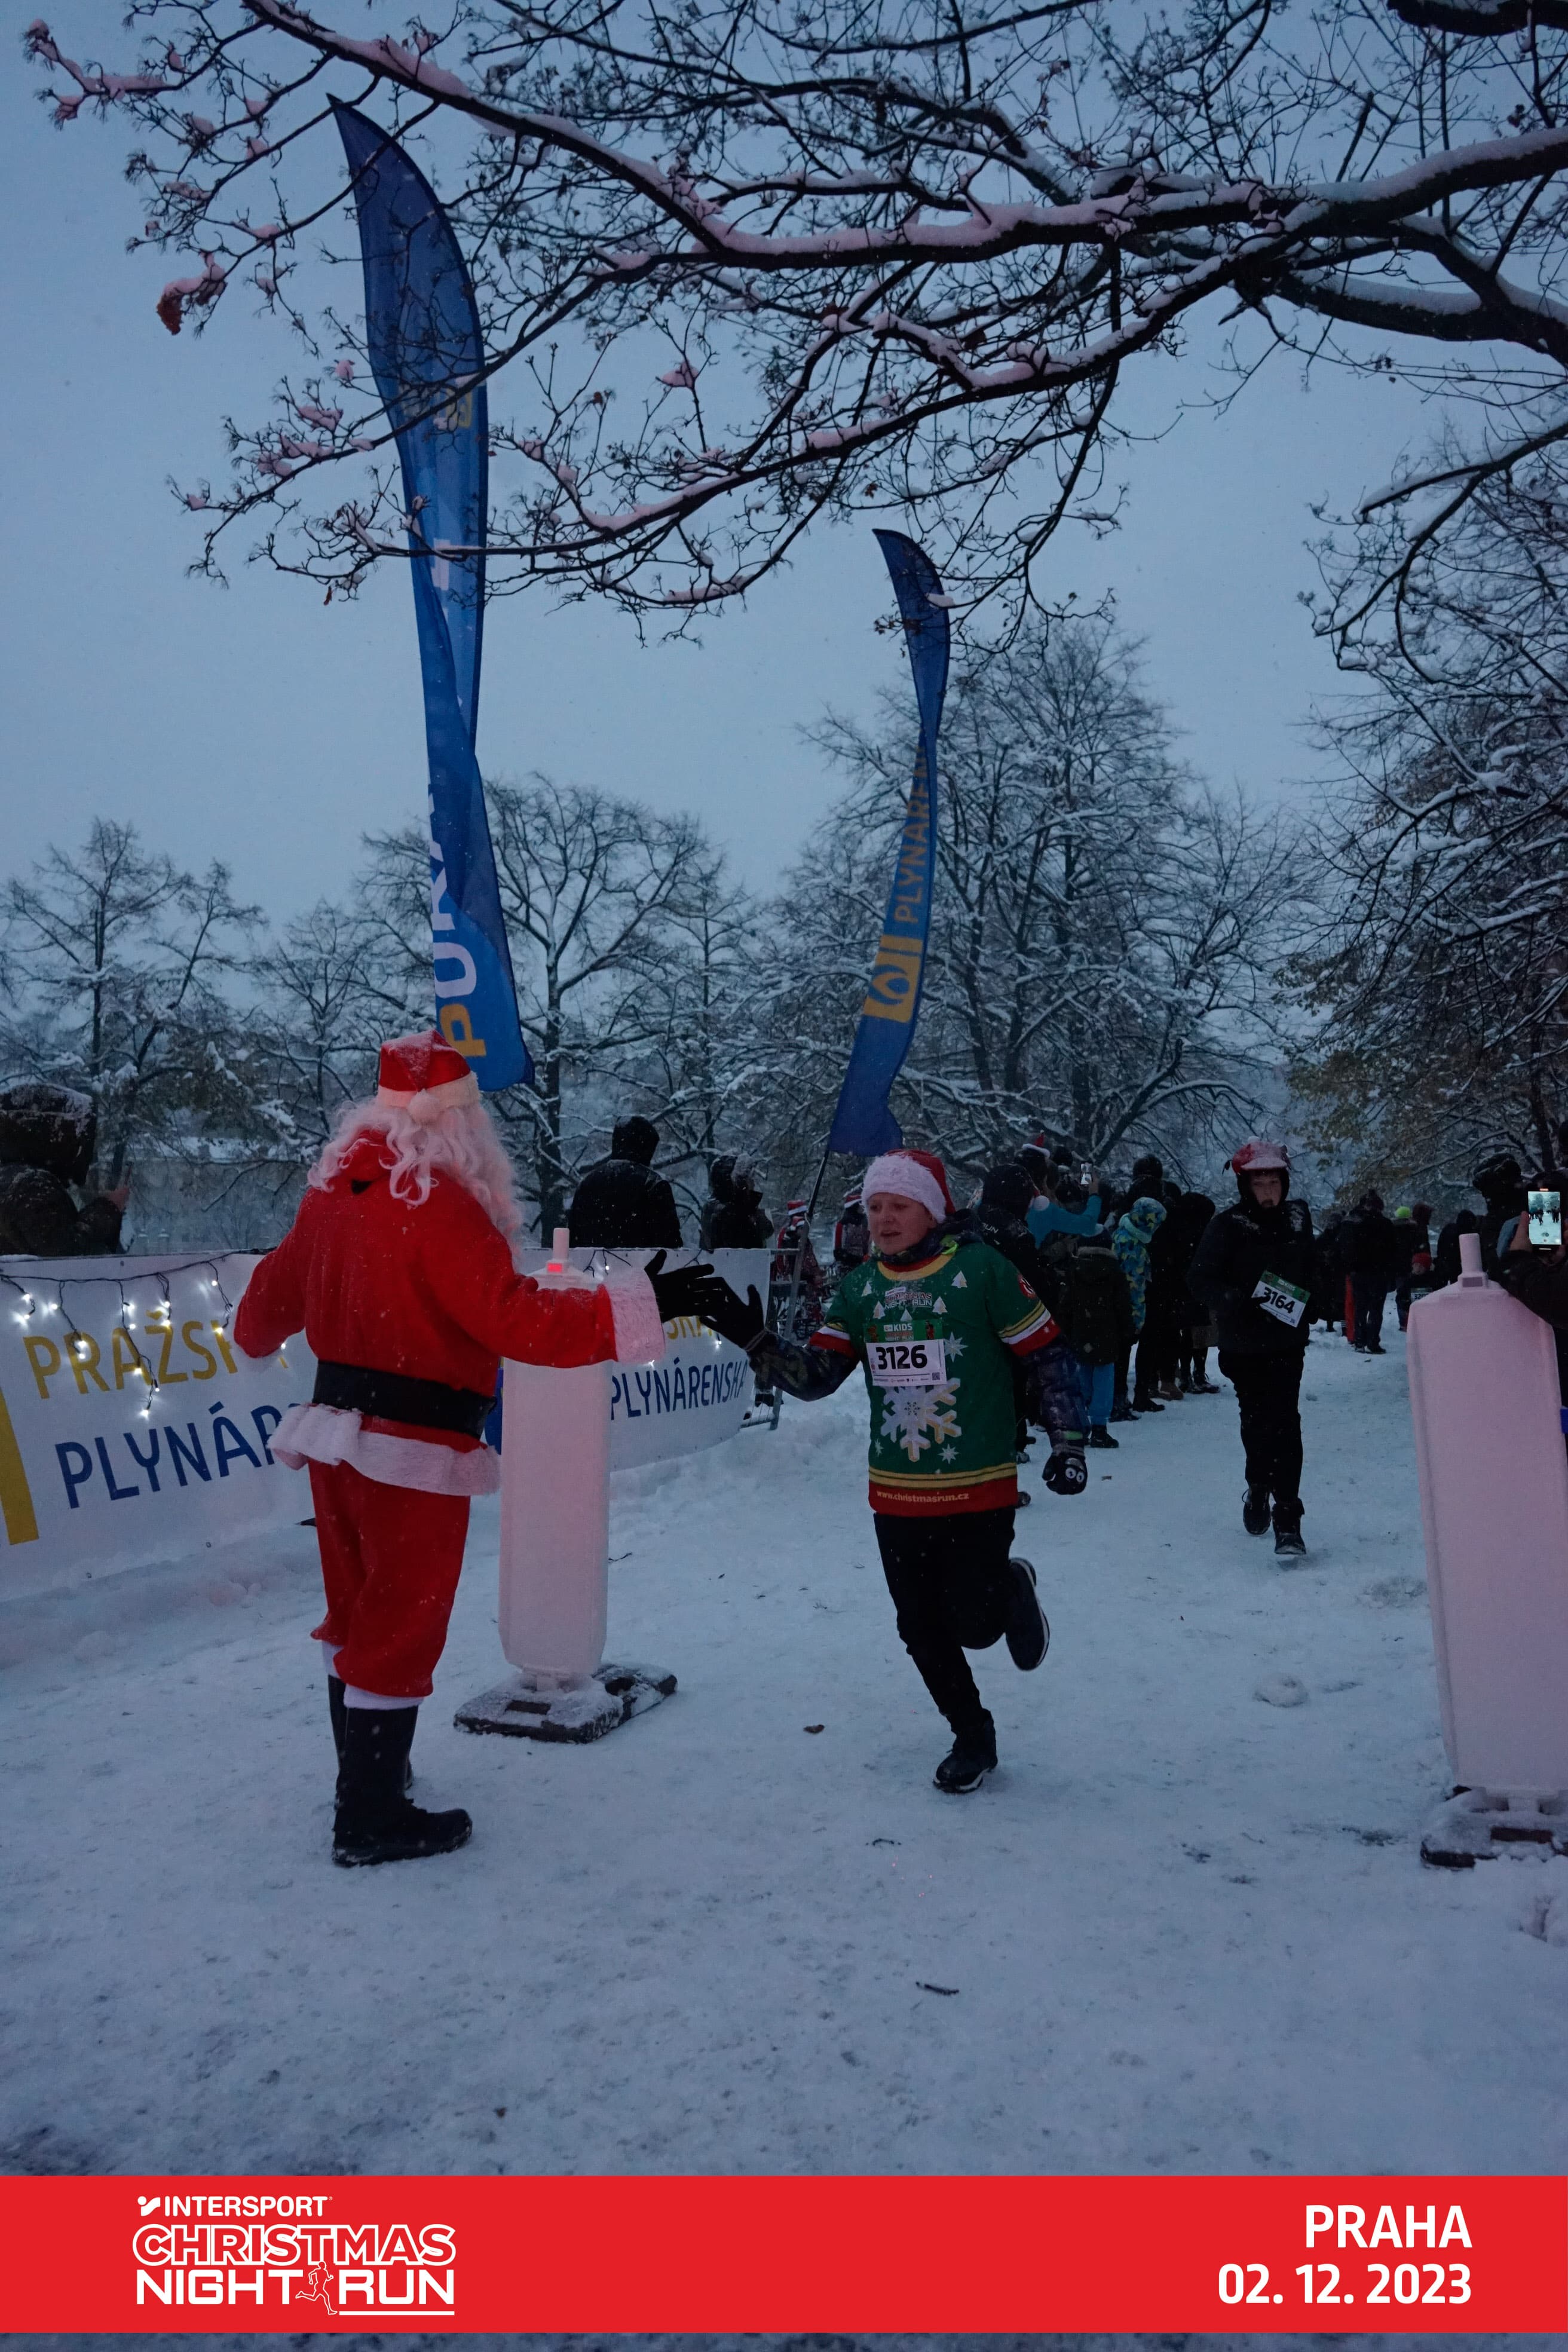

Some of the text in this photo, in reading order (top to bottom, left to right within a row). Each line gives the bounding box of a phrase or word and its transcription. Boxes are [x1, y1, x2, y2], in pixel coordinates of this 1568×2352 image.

[1264, 1287, 1296, 1313] 3164
[893, 1323, 913, 1331] KIDS
[876, 1345, 927, 1370] 3126
[876, 1490, 970, 1503] www.christmasrun.cz
